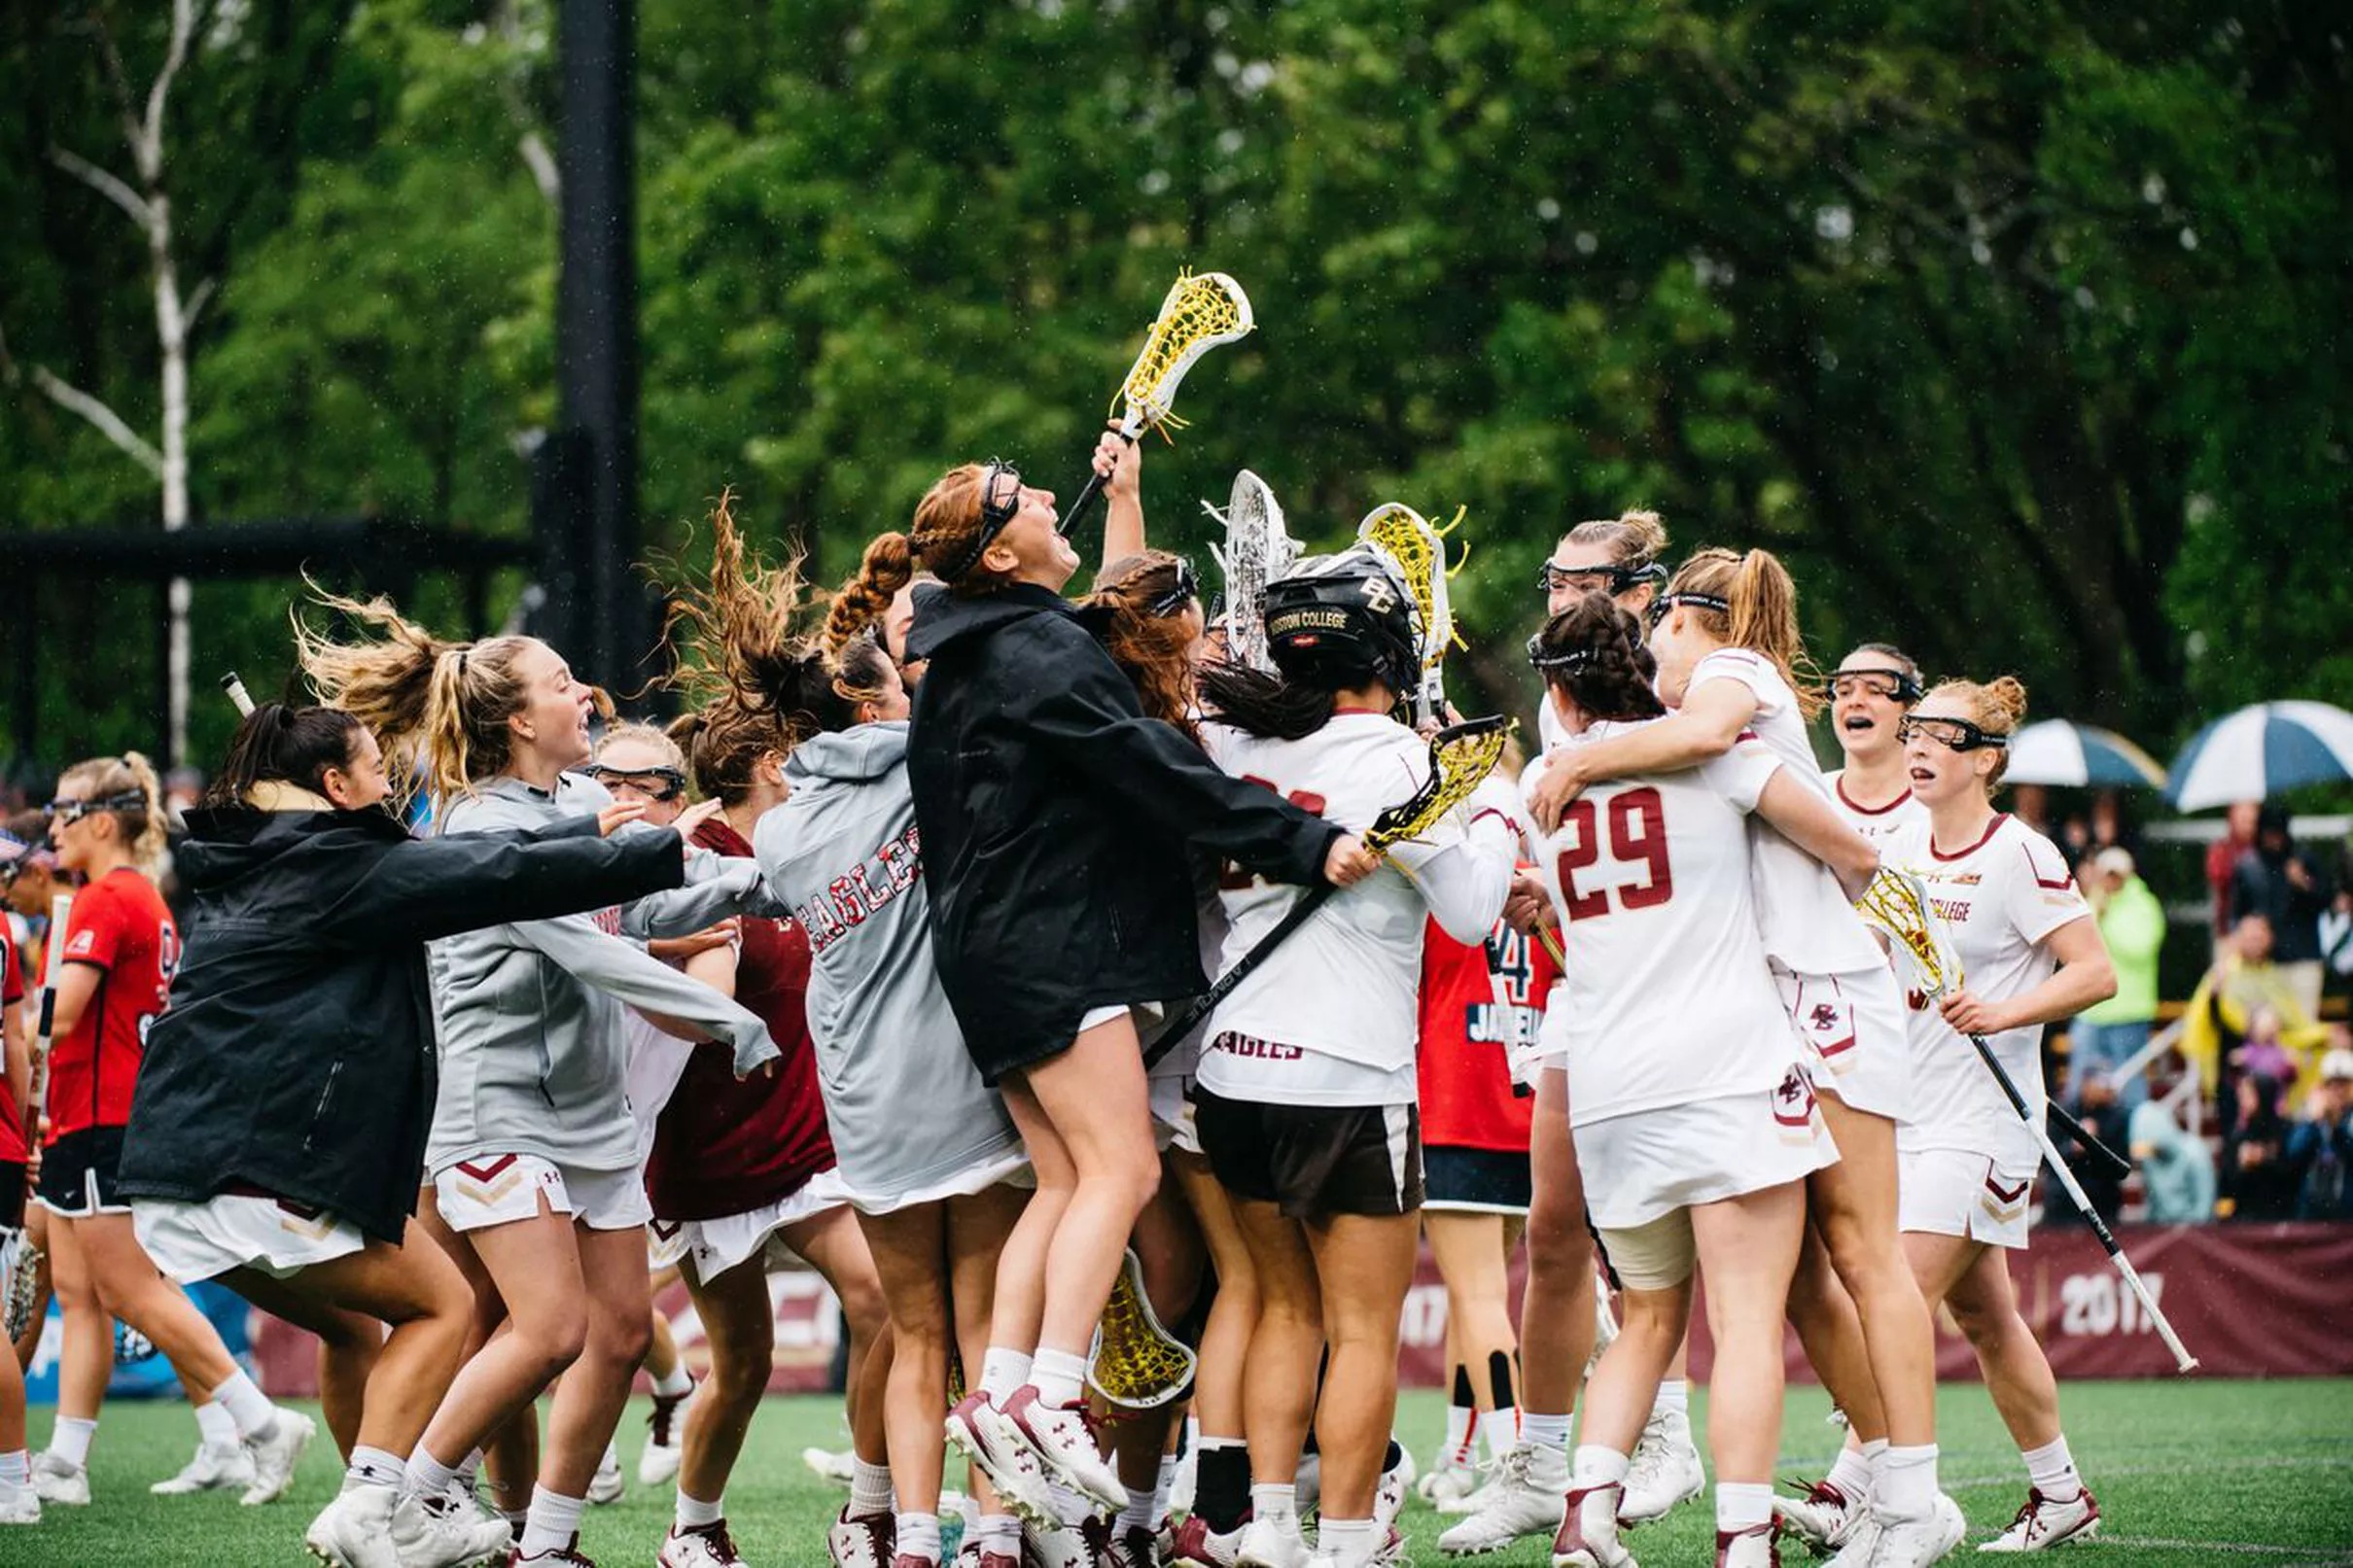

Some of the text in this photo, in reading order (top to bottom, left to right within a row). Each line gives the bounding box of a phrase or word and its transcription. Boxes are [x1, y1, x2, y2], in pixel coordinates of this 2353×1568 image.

[1359, 575, 1395, 614] BC
[1302, 610, 1348, 629] COLLEGE
[1558, 785, 1673, 922] 29
[1929, 897, 1972, 923] OLLEGE
[2060, 1272, 2165, 1336] 2017
